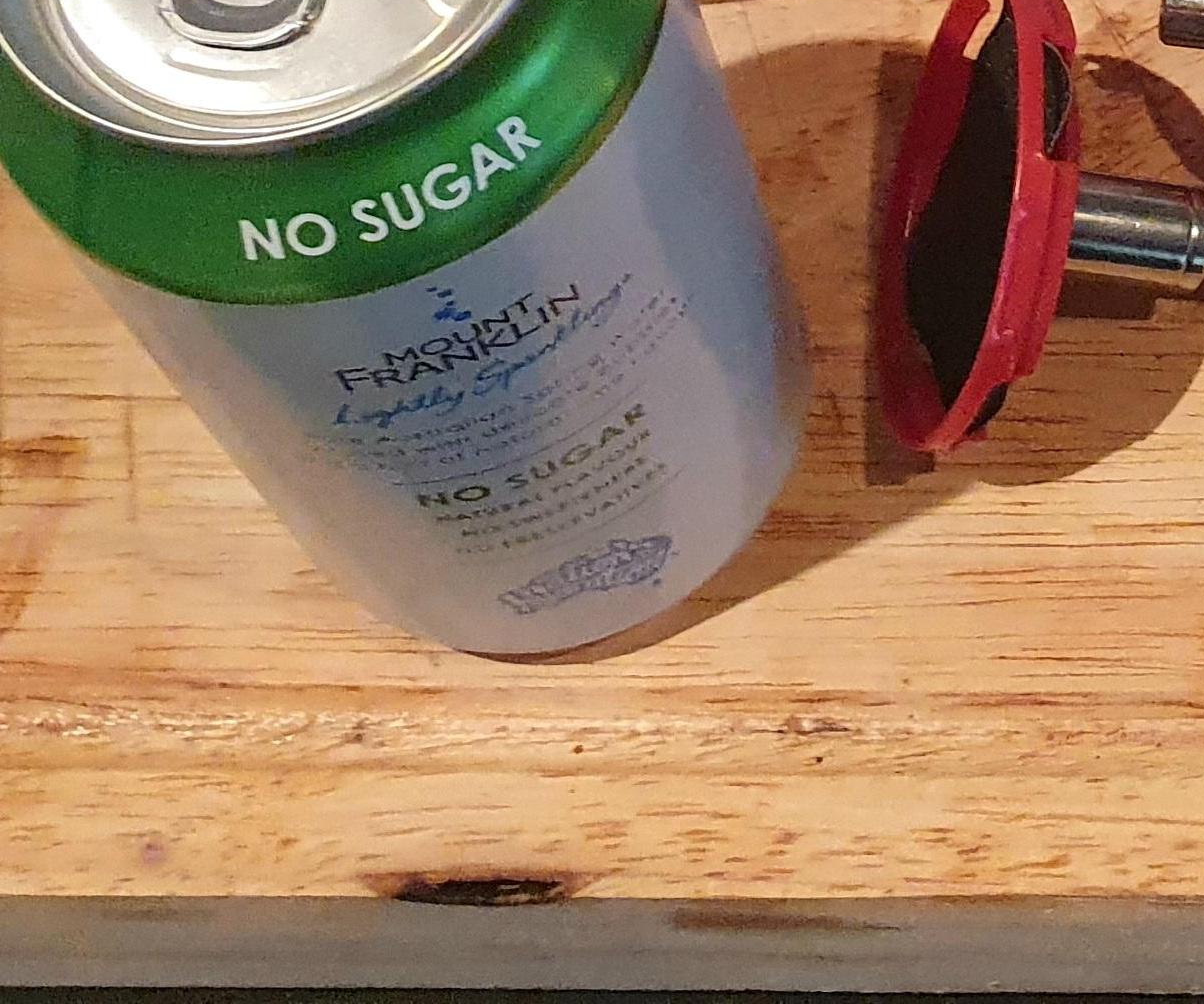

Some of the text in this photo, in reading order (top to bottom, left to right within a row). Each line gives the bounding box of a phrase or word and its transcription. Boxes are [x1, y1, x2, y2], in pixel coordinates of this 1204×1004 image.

[239, 116, 542, 260] NO SUGAR
[335, 284, 579, 391] FRANKLIN
[384, 292, 533, 366] MOUNT
[417, 484, 491, 508] NO
[505, 402, 645, 490] SUGAR
